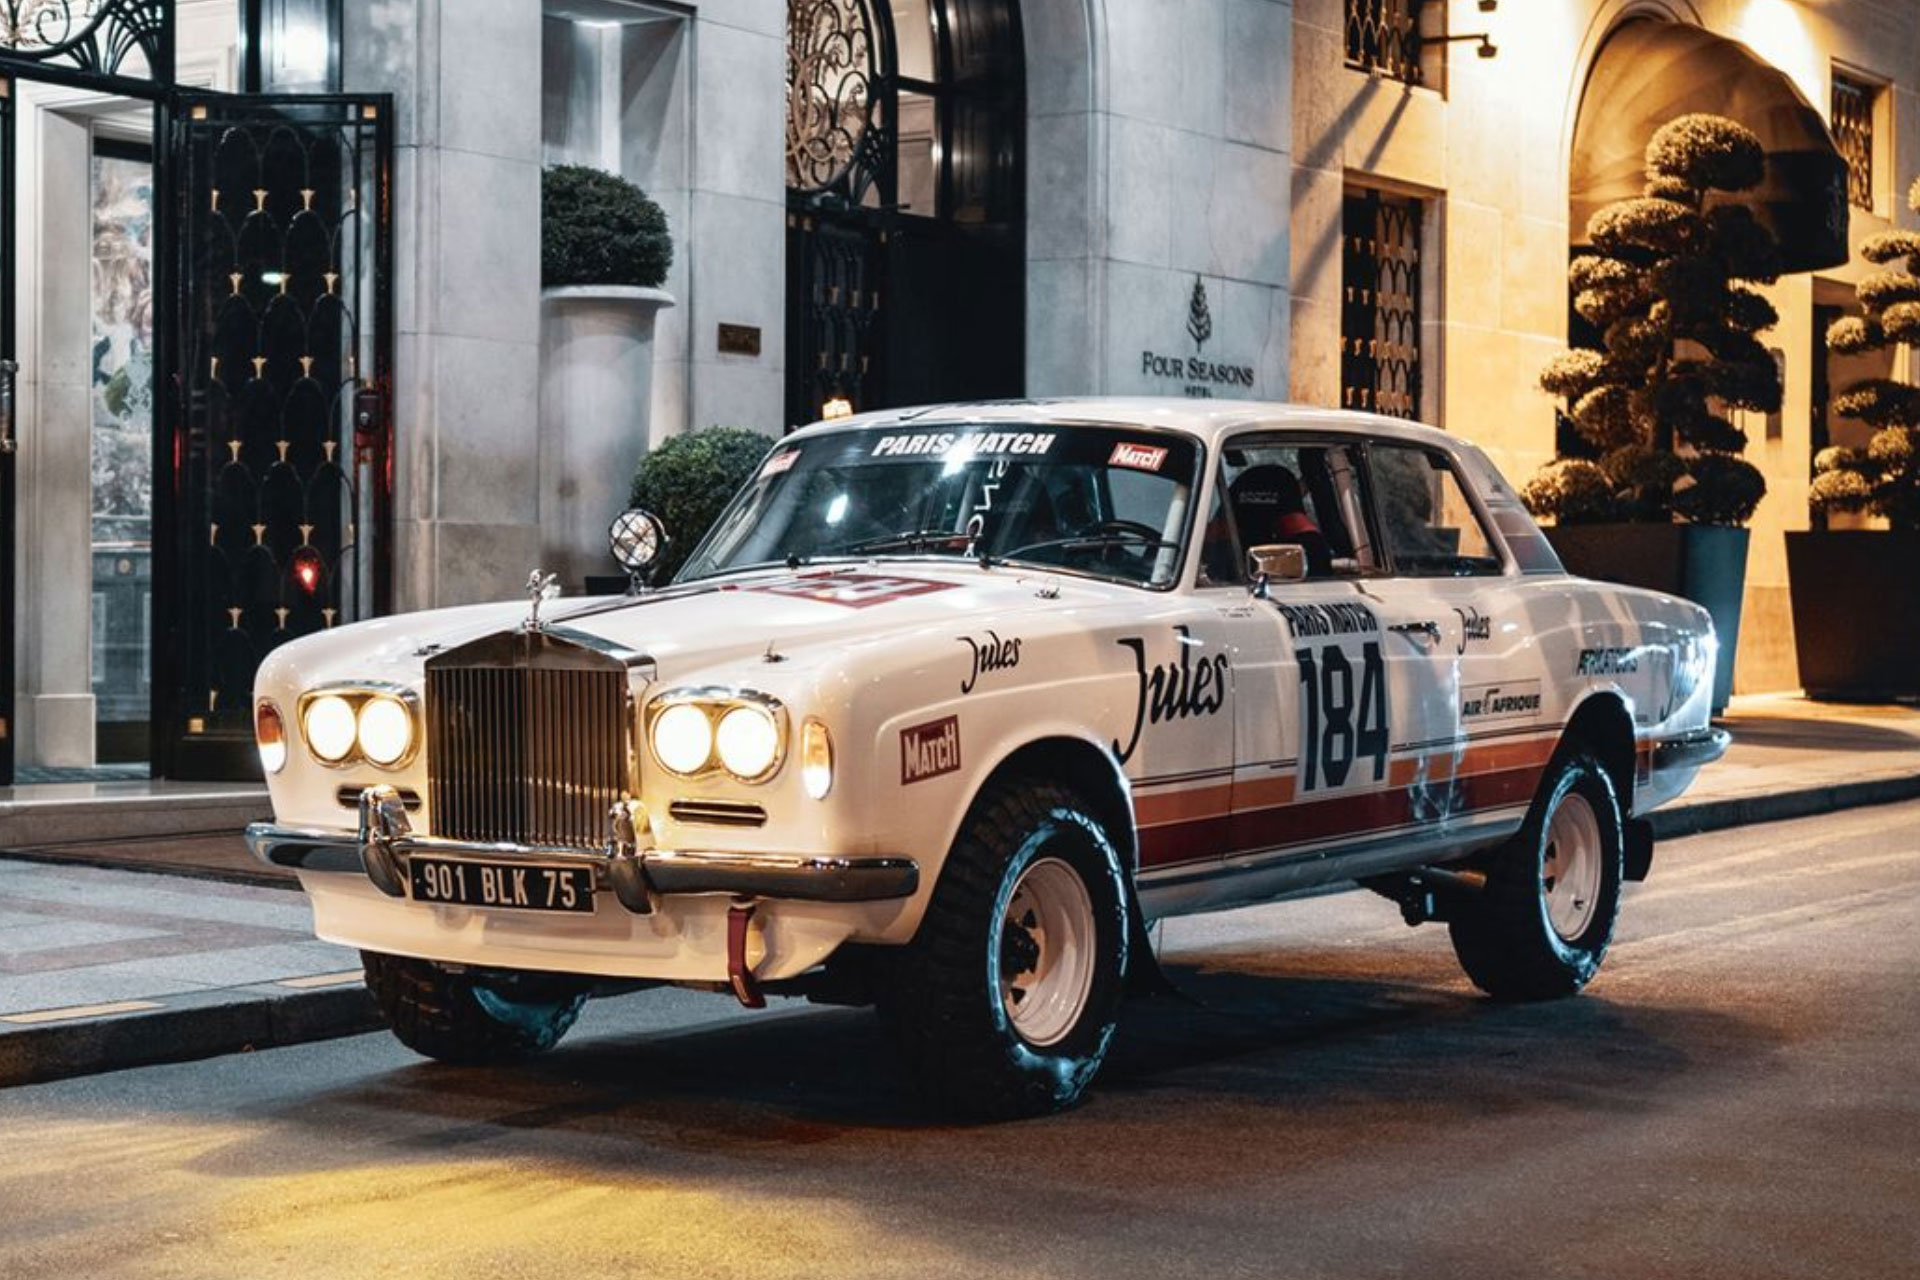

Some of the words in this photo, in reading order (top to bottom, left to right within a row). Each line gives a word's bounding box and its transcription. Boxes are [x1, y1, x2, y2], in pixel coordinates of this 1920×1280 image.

[1142, 351, 1184, 379] FOUR
[1187, 357, 1254, 387] SEASONS
[871, 434, 955, 457] PARIS
[1278, 605, 1330, 638] PARIS
[957, 630, 1022, 694] Jules
[1112, 624, 1228, 767] Jules
[1295, 641, 1390, 792] 184
[1462, 699, 1482, 717] AIR
[1491, 693, 1541, 714] AFRIQUE
[903, 722, 958, 780] MATCH
[423, 863, 466, 902] 901
[480, 867, 529, 906] BLK
[542, 871, 577, 908] 75
